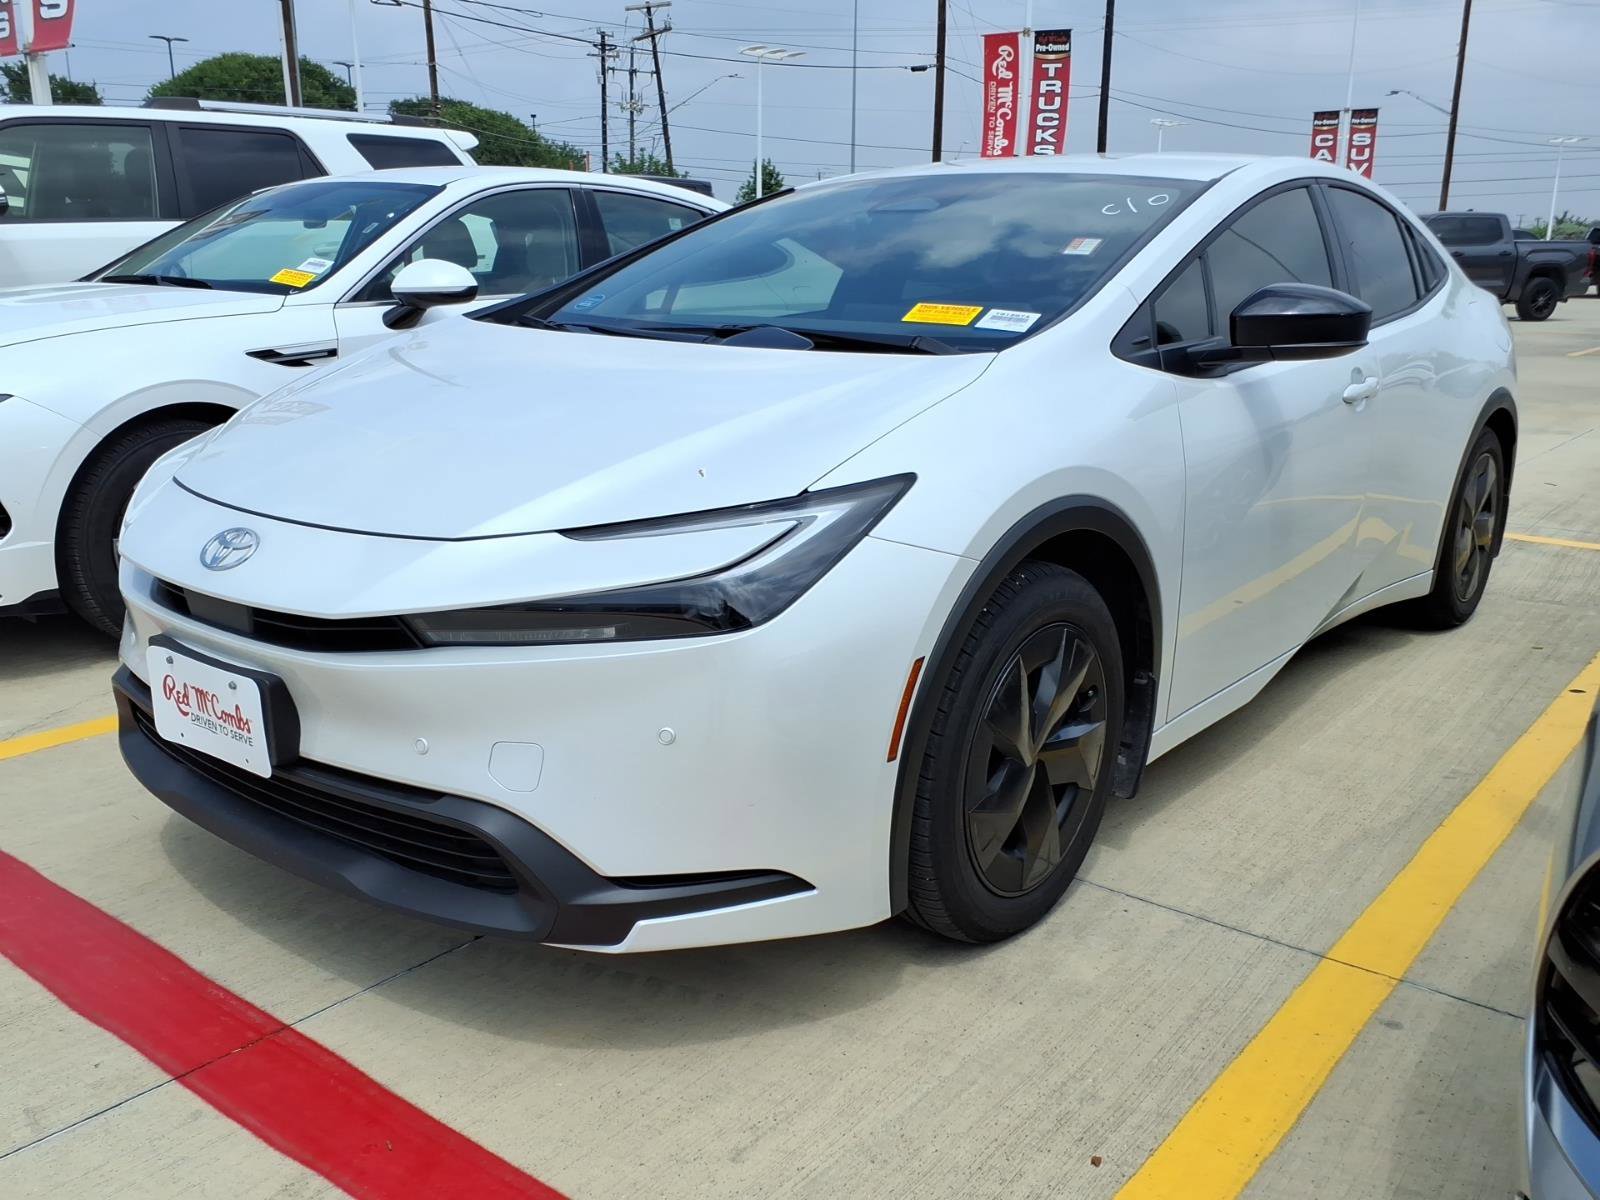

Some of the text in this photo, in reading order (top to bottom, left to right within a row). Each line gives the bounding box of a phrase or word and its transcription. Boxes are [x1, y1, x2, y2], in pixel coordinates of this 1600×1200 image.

[1035, 43, 1070, 52] Pre-Owned
[988, 116, 996, 128] TO
[992, 45, 1014, 156] Red McCombs
[1033, 63, 1062, 156] TRUCKS
[162, 674, 251, 734] Red McCombs
[191, 712, 254, 747] DRIVEN TO SERVE
